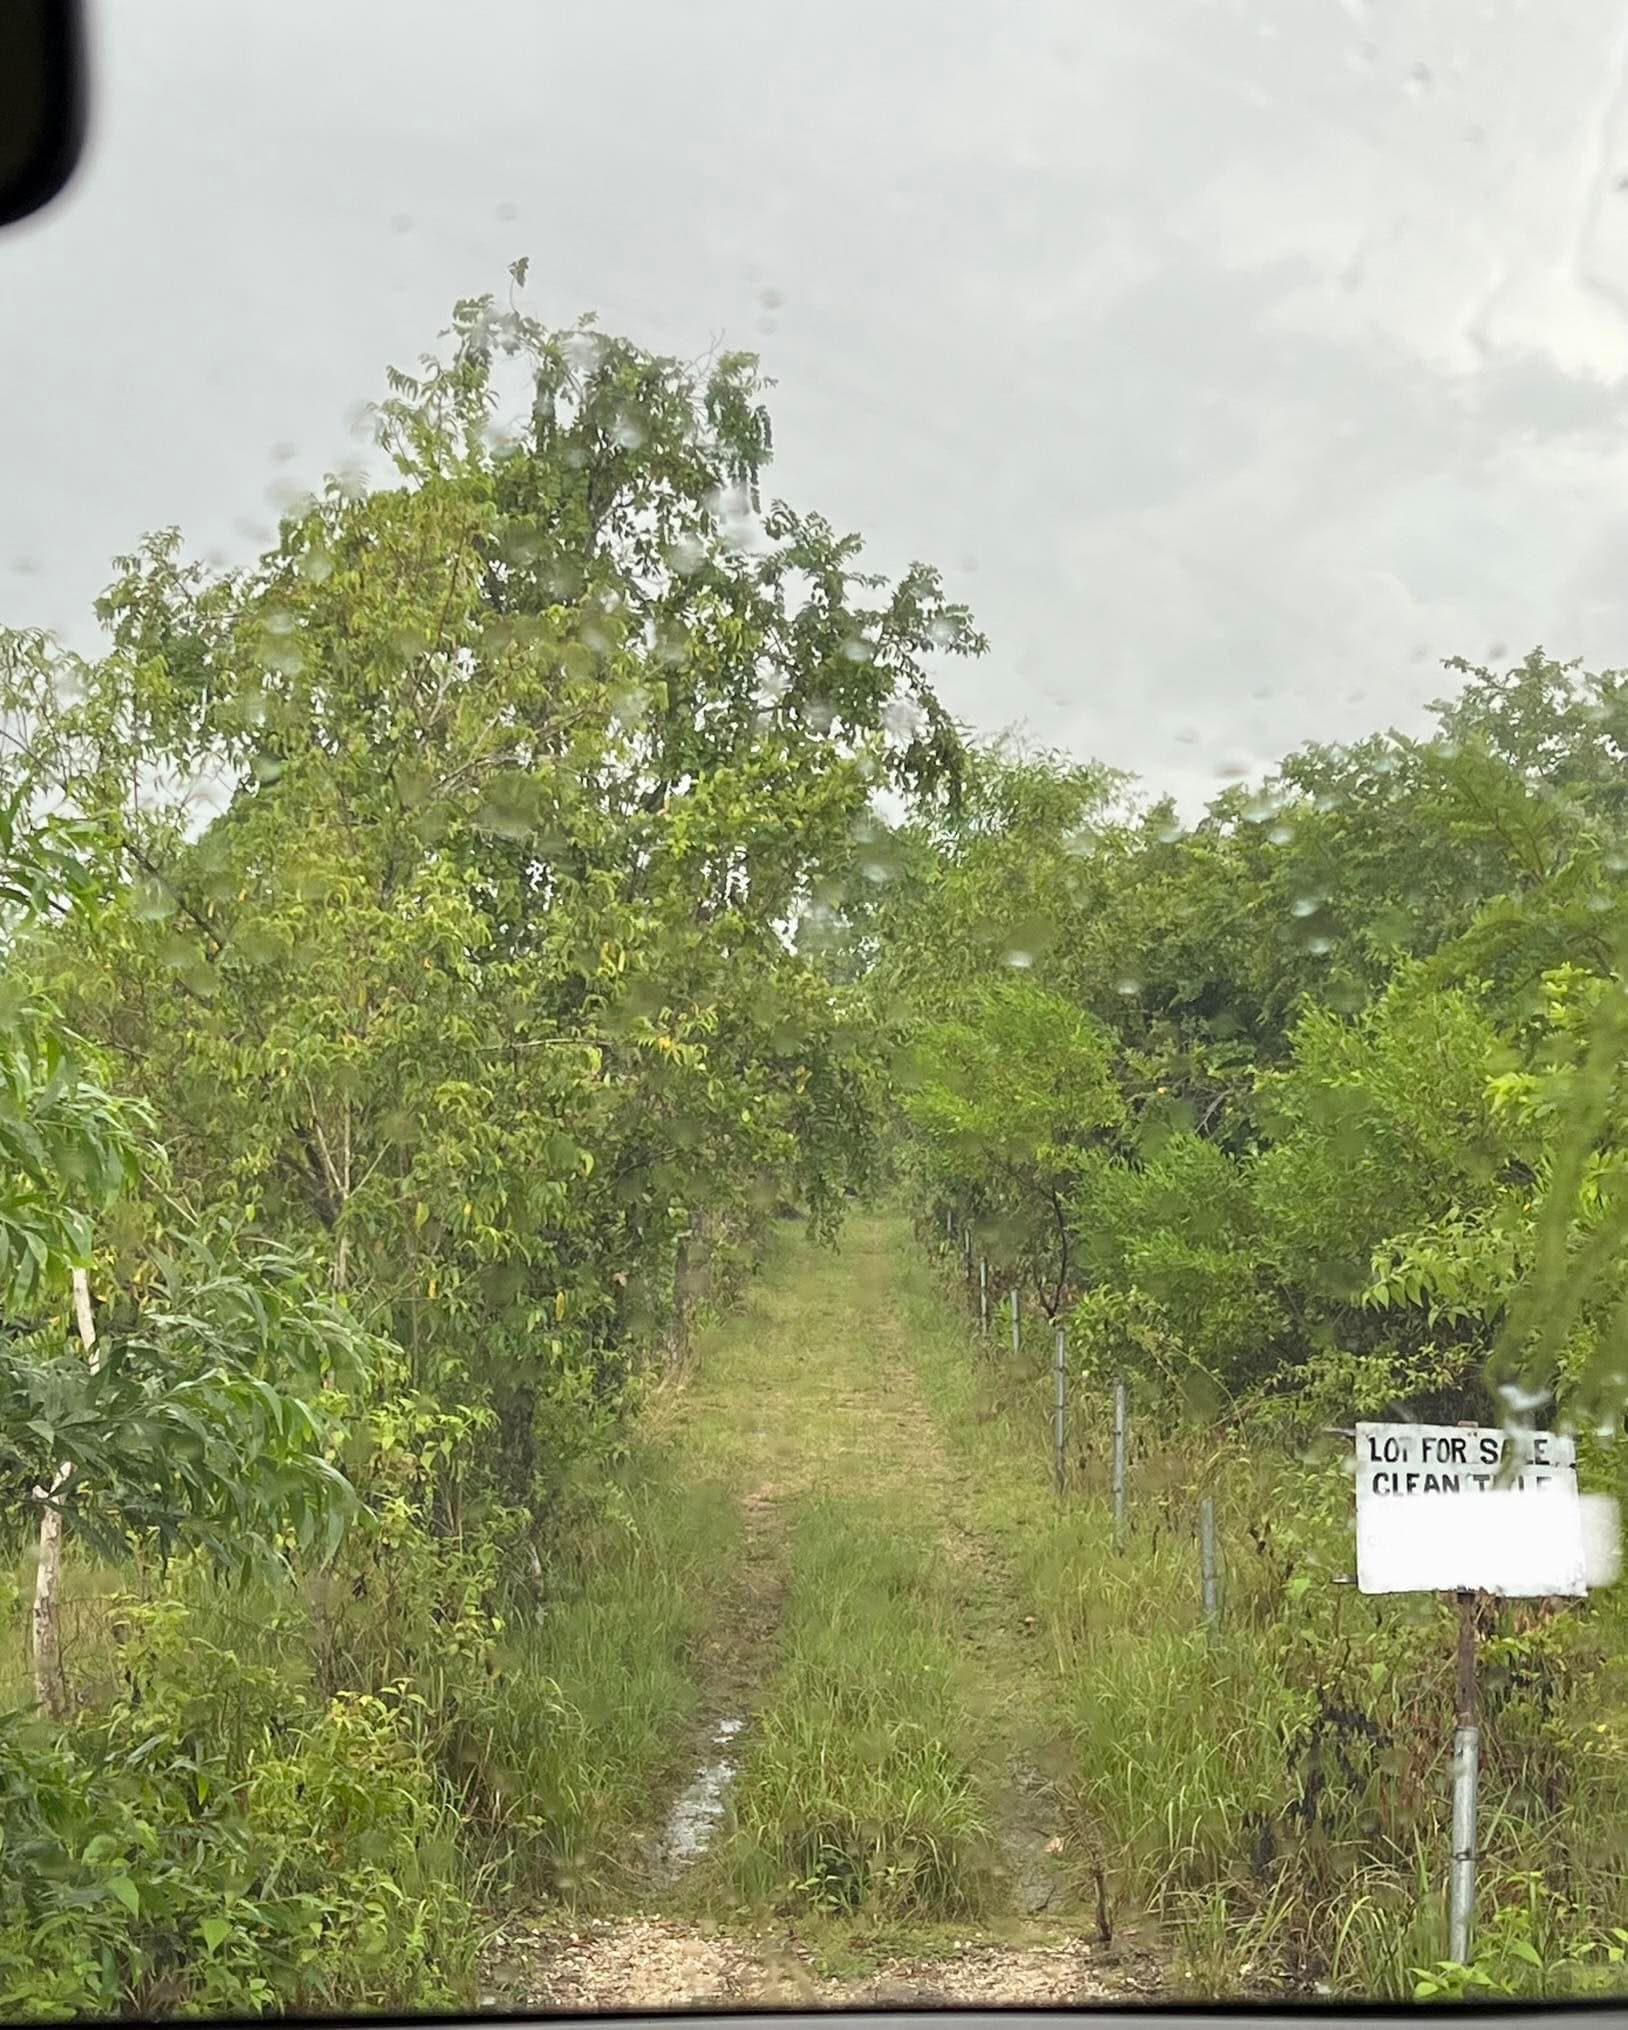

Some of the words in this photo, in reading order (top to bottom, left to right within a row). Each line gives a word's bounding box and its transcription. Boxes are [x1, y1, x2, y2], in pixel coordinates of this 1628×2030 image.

[1368, 1436, 1412, 1463] LOT
[1422, 1438, 1467, 1464] FOR
[1480, 1438, 1550, 1466] SE
[1372, 1472, 1460, 1497] CLEAN
